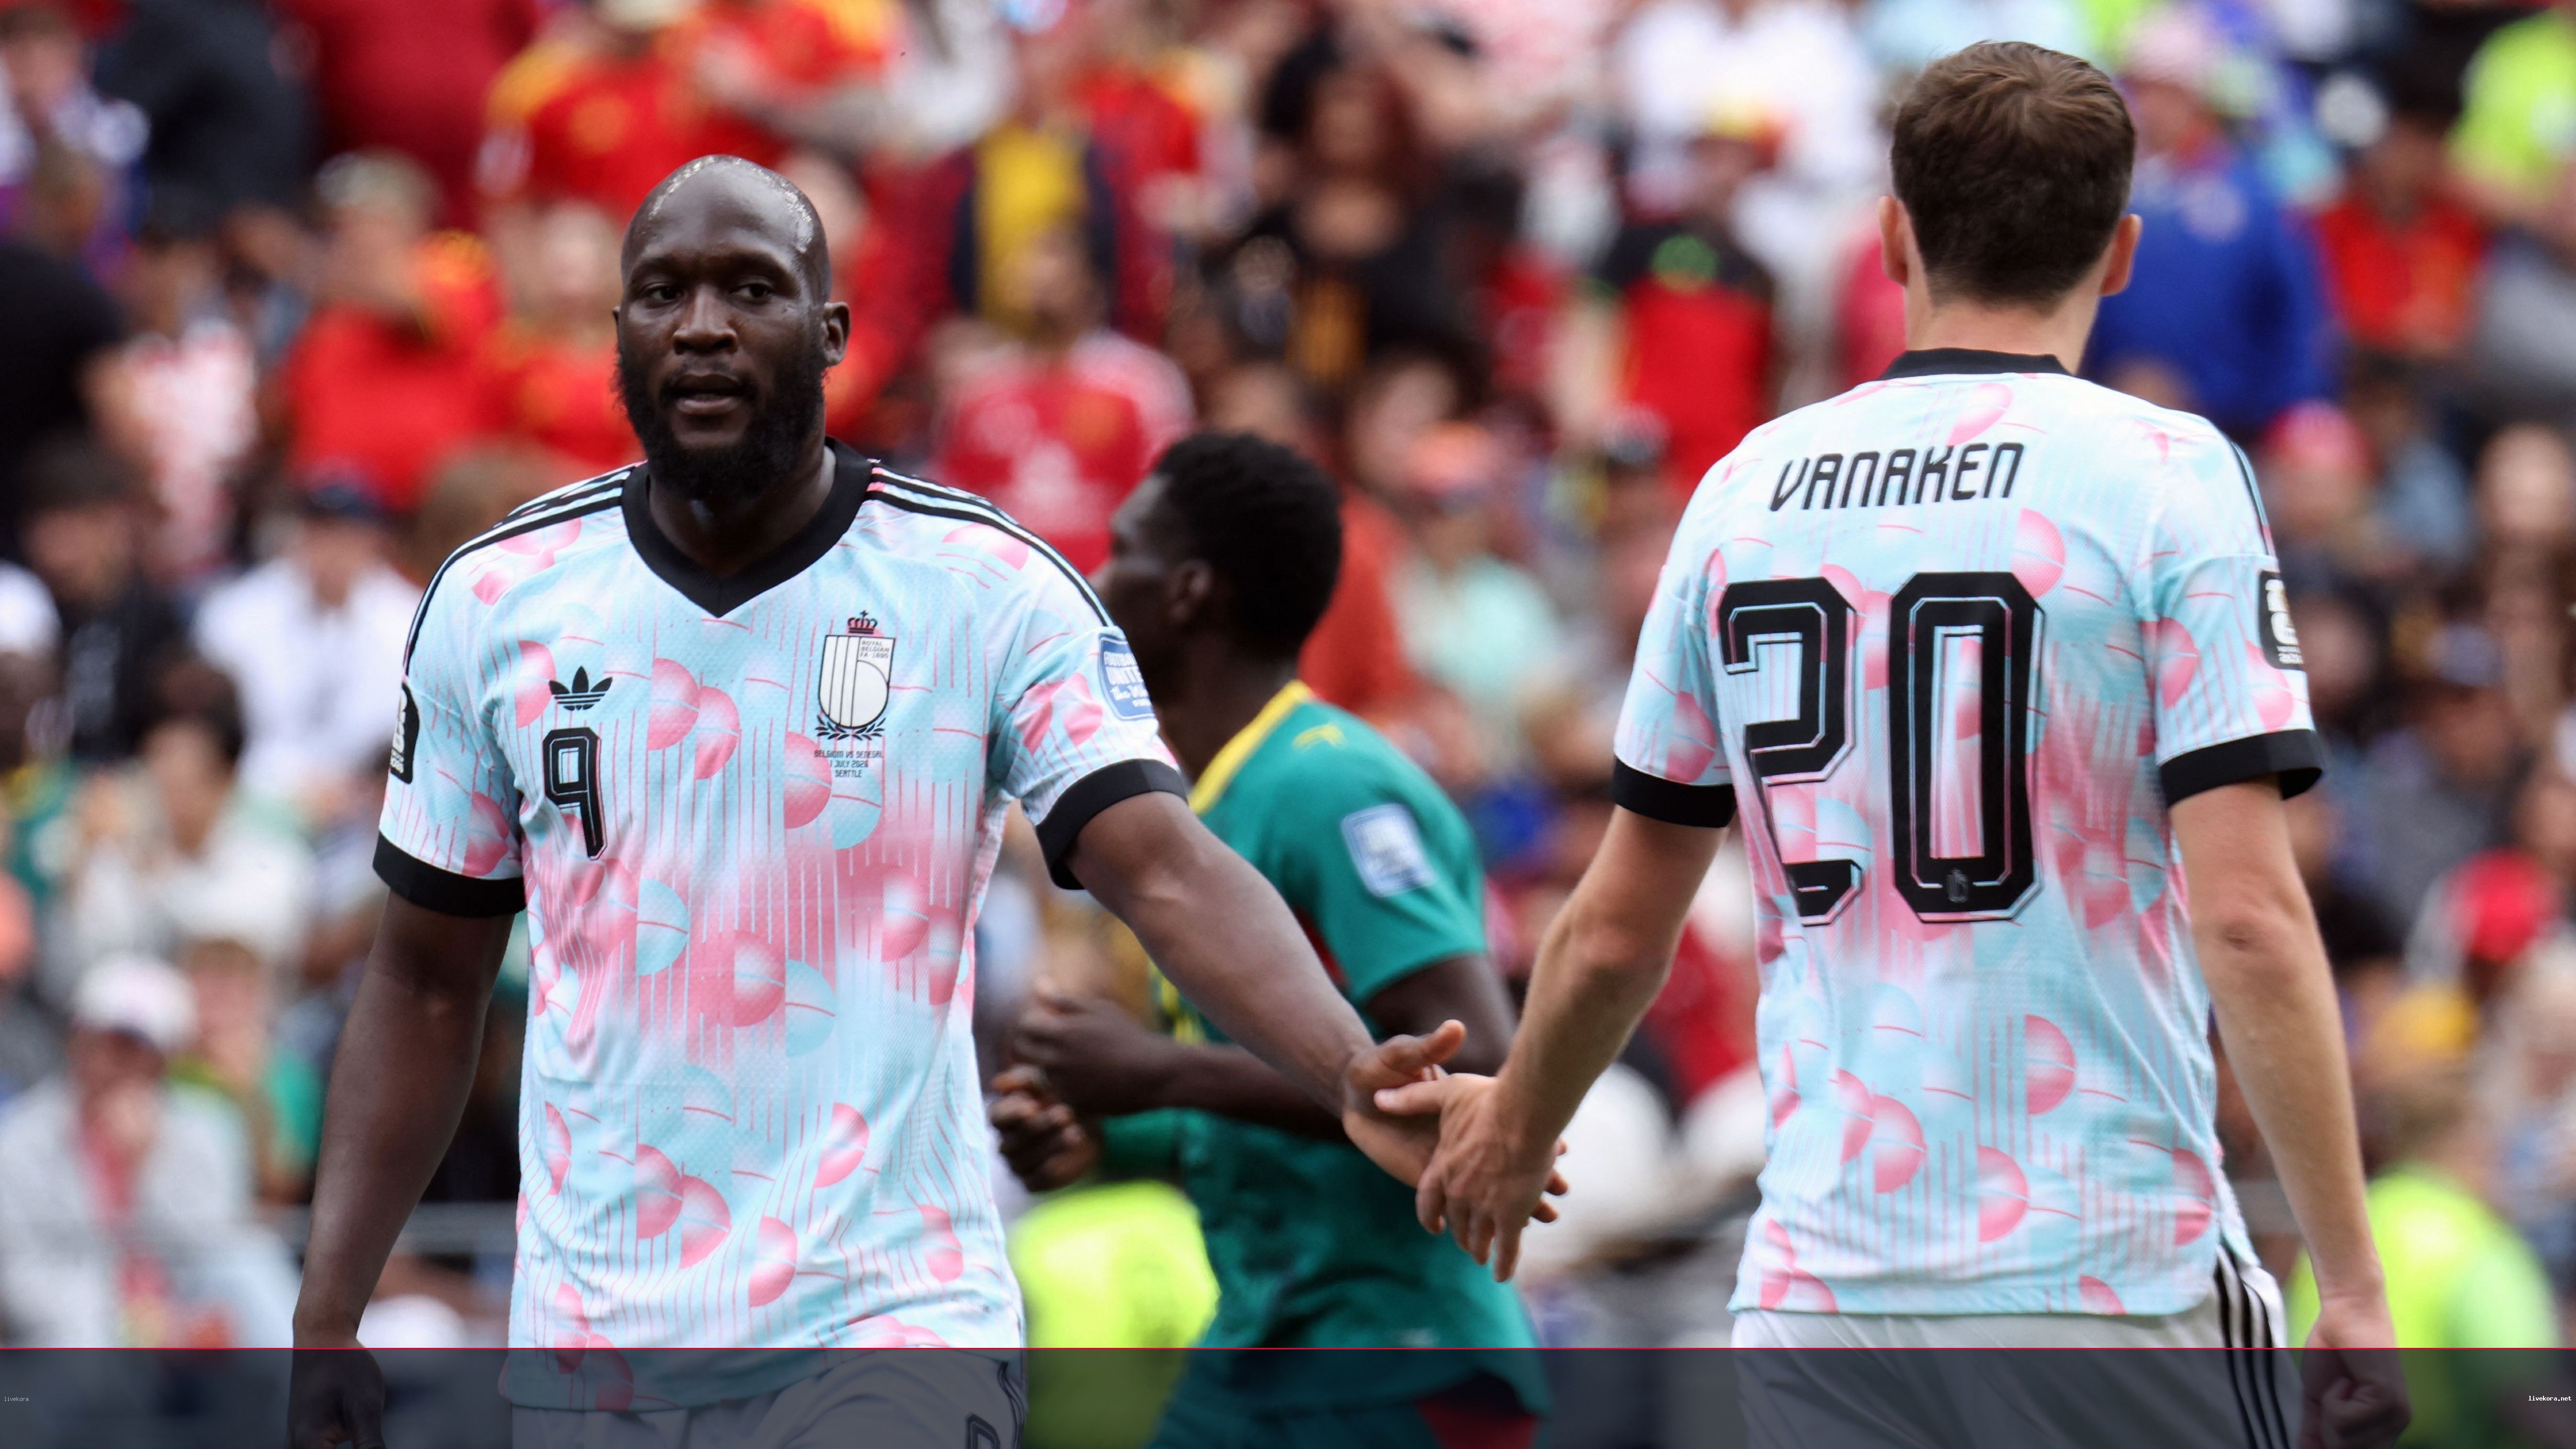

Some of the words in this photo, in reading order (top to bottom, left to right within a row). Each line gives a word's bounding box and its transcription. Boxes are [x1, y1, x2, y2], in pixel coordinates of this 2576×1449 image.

[1770, 443, 2024, 511] VANAKEN
[542, 727, 607, 860] 9
[834, 769, 863, 778] SEATTLE
[1717, 572, 2047, 926] 20
